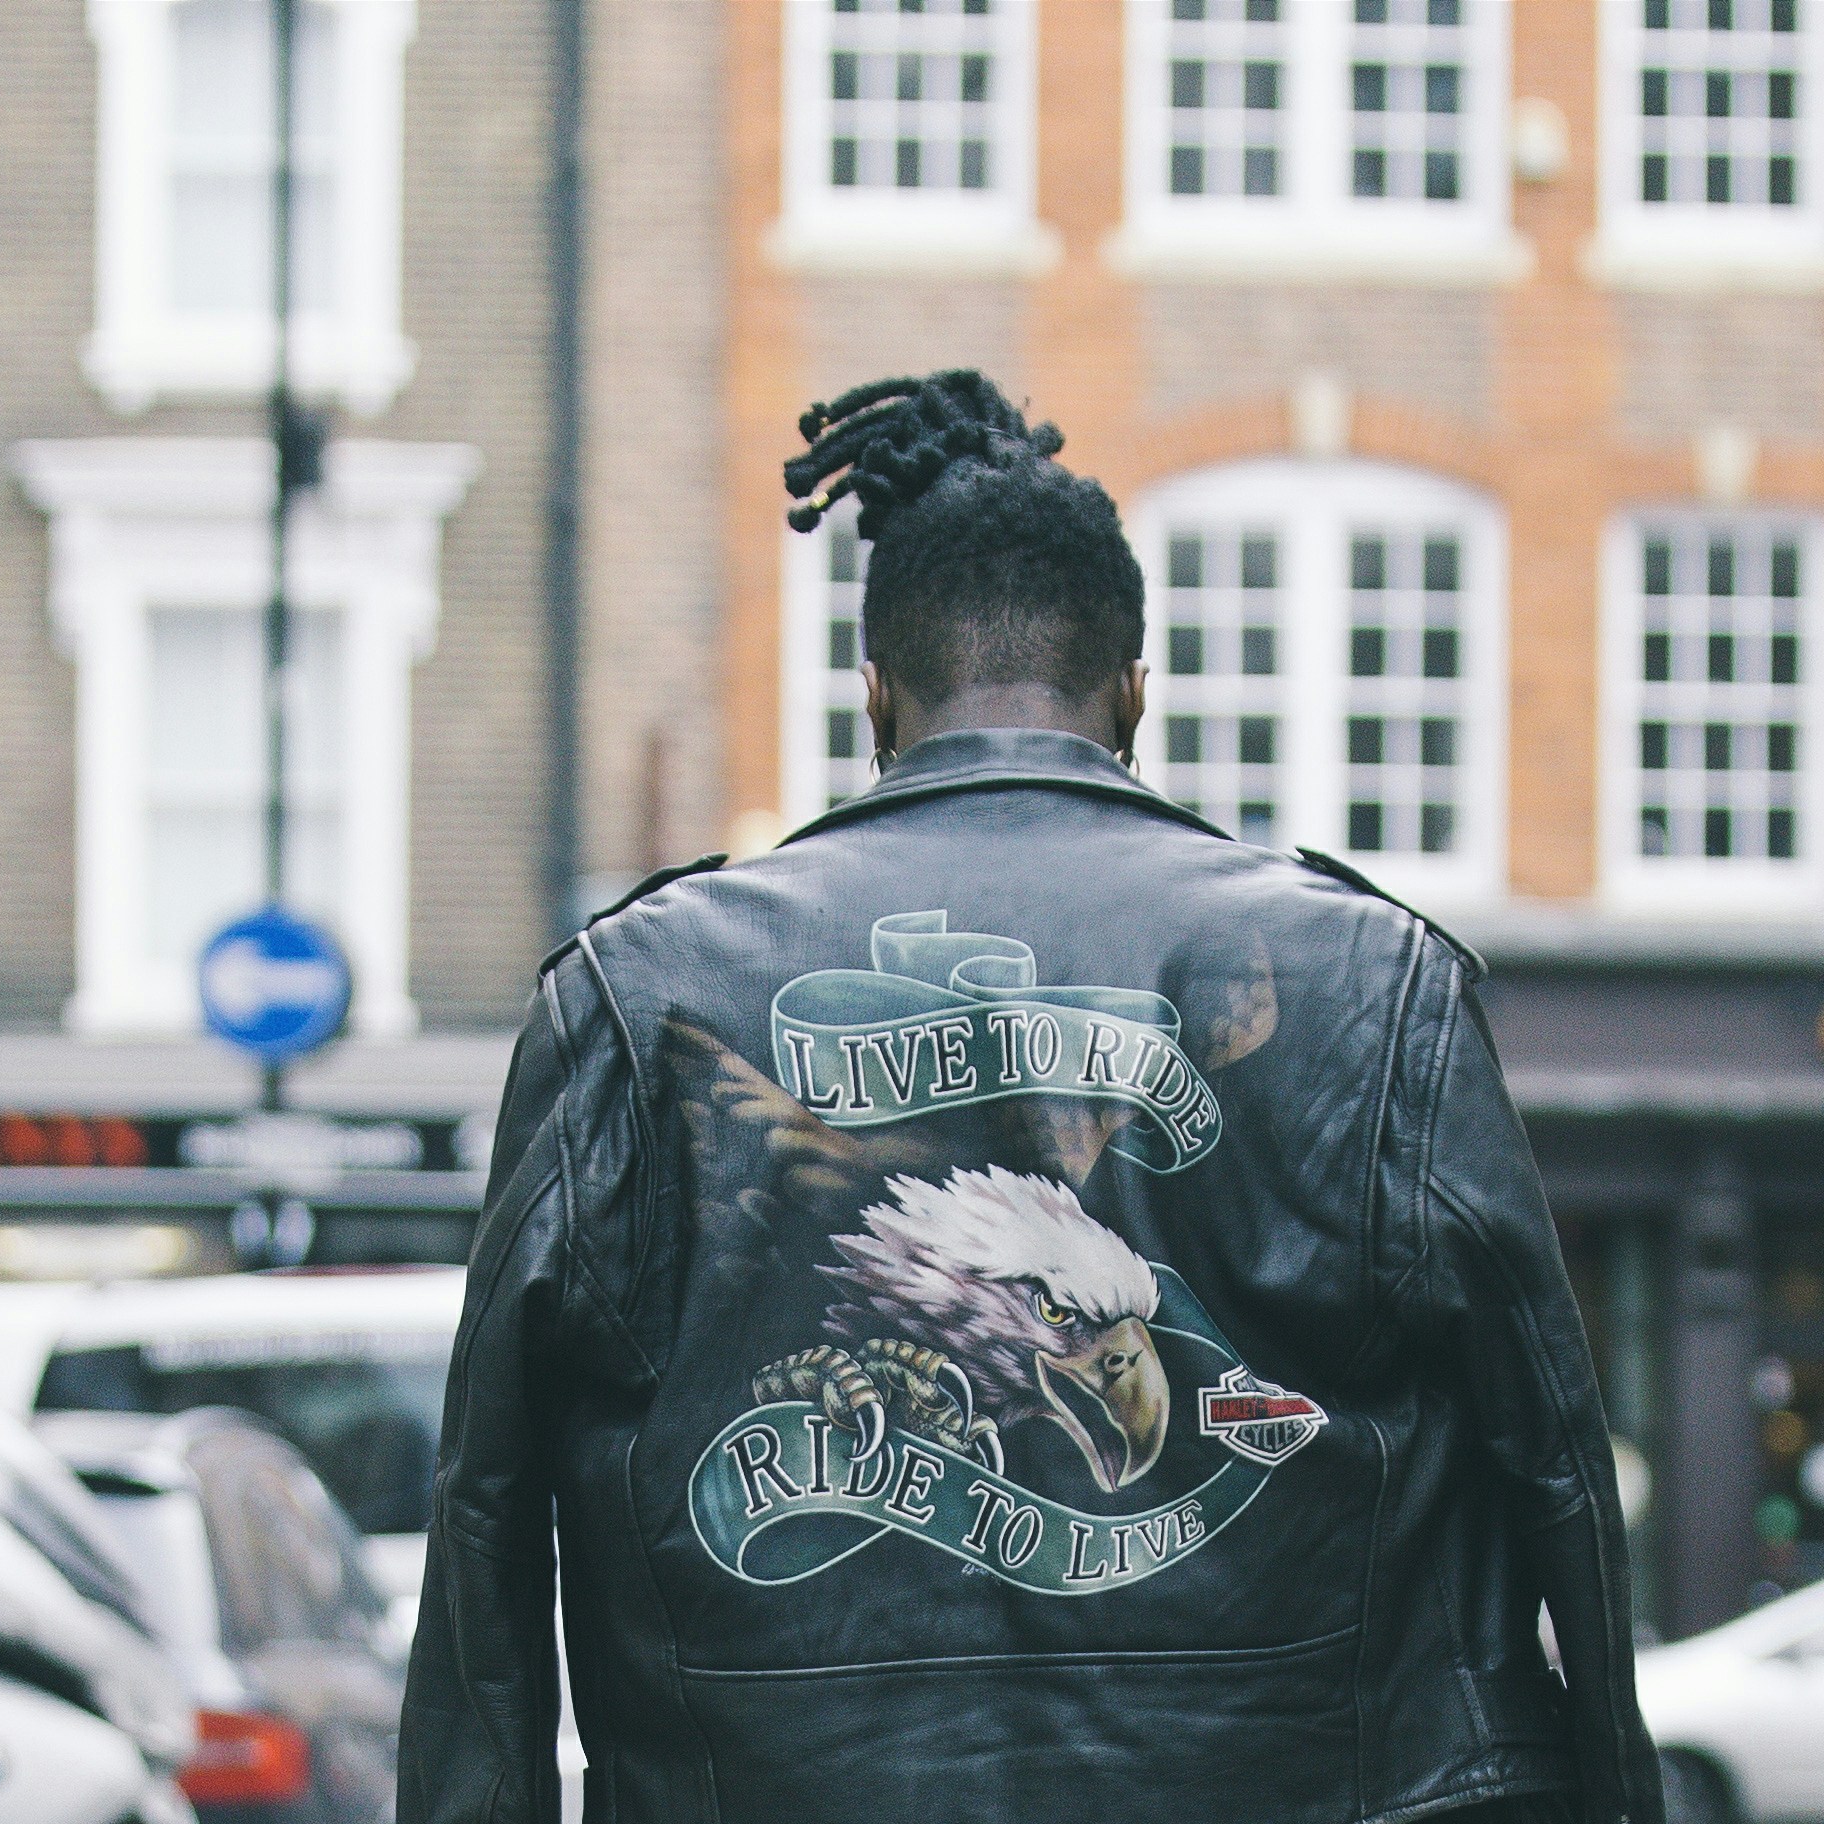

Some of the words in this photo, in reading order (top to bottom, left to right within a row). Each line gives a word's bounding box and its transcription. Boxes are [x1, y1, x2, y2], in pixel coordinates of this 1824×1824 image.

[784, 1017, 977, 1114] LIVE
[988, 1009, 1062, 1083] TO
[1079, 1019, 1217, 1152] RIDE
[726, 1415, 945, 1528] RIDE
[961, 1480, 1044, 1567] TO
[1064, 1499, 1206, 1583] LIVE
[1240, 1419, 1304, 1450] CYCLES
